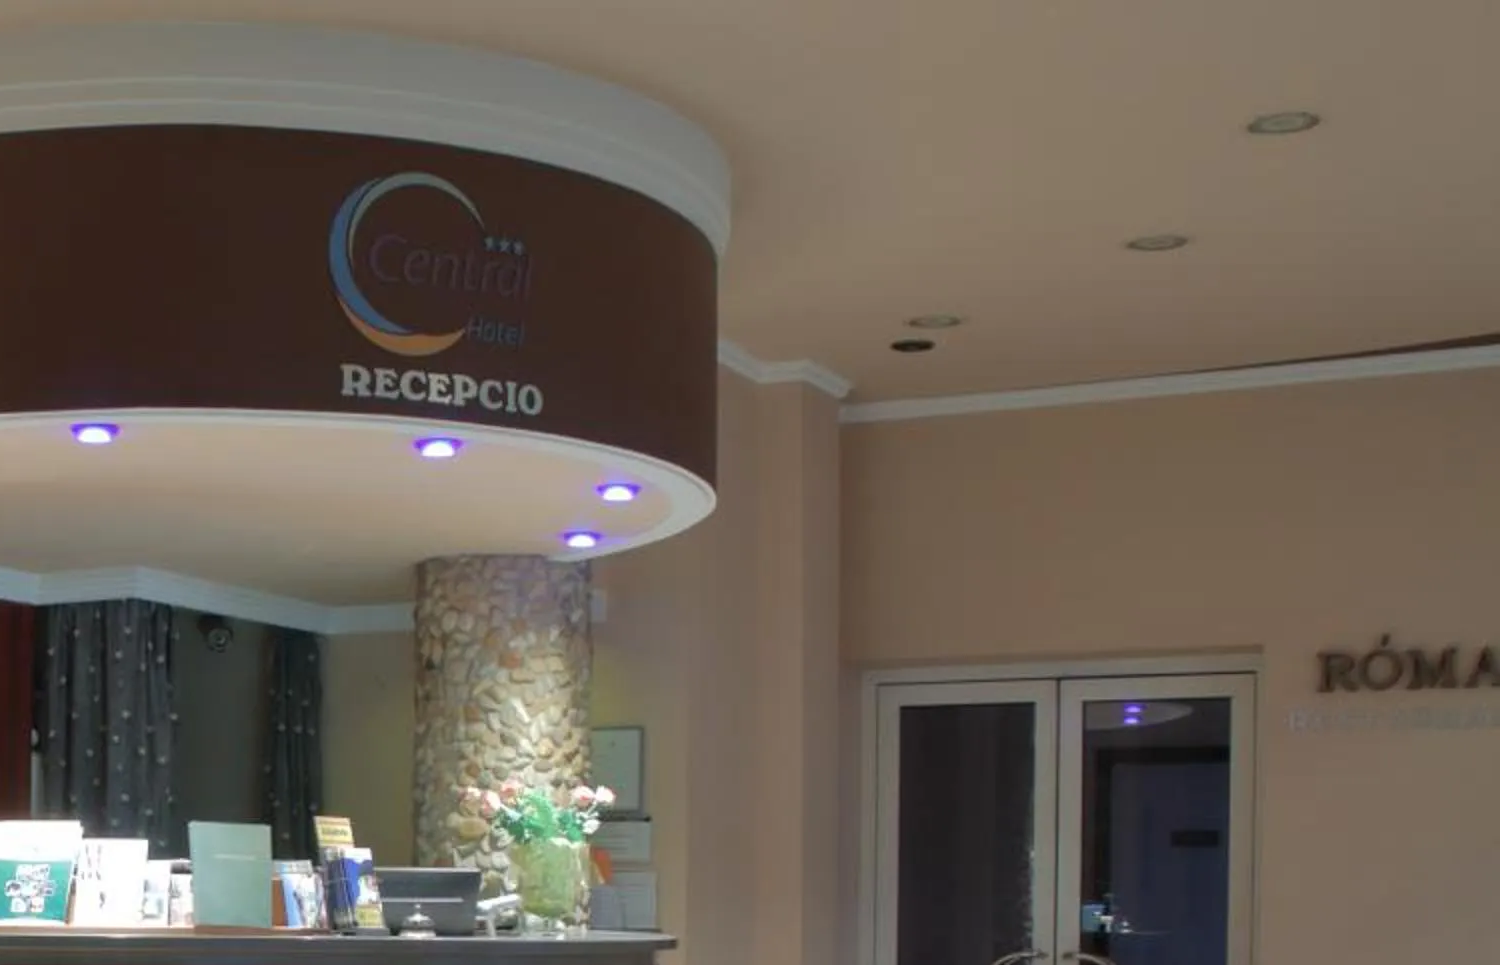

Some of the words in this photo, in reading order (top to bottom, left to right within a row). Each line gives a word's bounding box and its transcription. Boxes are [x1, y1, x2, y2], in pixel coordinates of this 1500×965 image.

[368, 233, 532, 302] Central
[467, 317, 525, 347] Hotel
[340, 363, 544, 416] RECEPCIO
